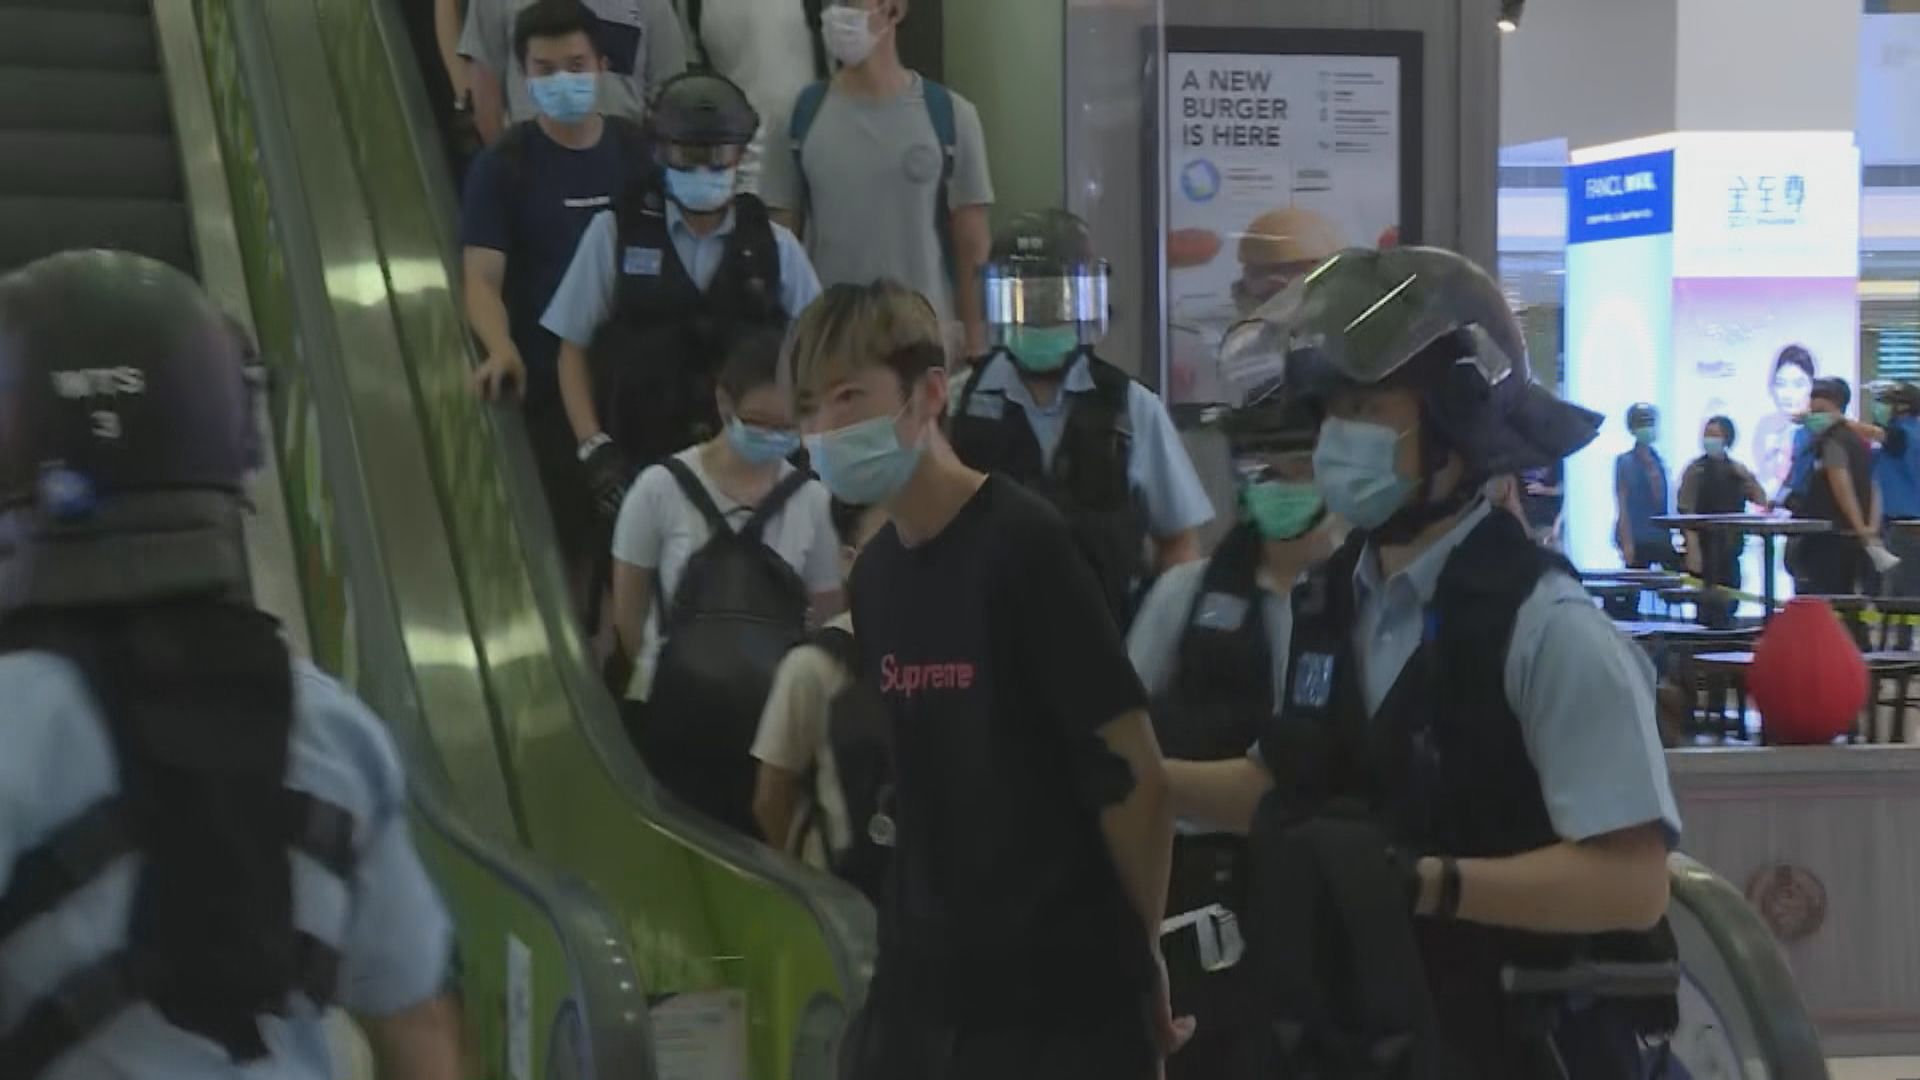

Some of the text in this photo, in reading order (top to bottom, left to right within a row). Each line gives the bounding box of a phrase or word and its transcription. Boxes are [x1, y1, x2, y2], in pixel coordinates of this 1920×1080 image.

[1182, 70, 1272, 92] A NEW
[1183, 97, 1288, 120] BURGER
[1183, 124, 1281, 147] IS HERE
[880, 653, 975, 698] Supreme
